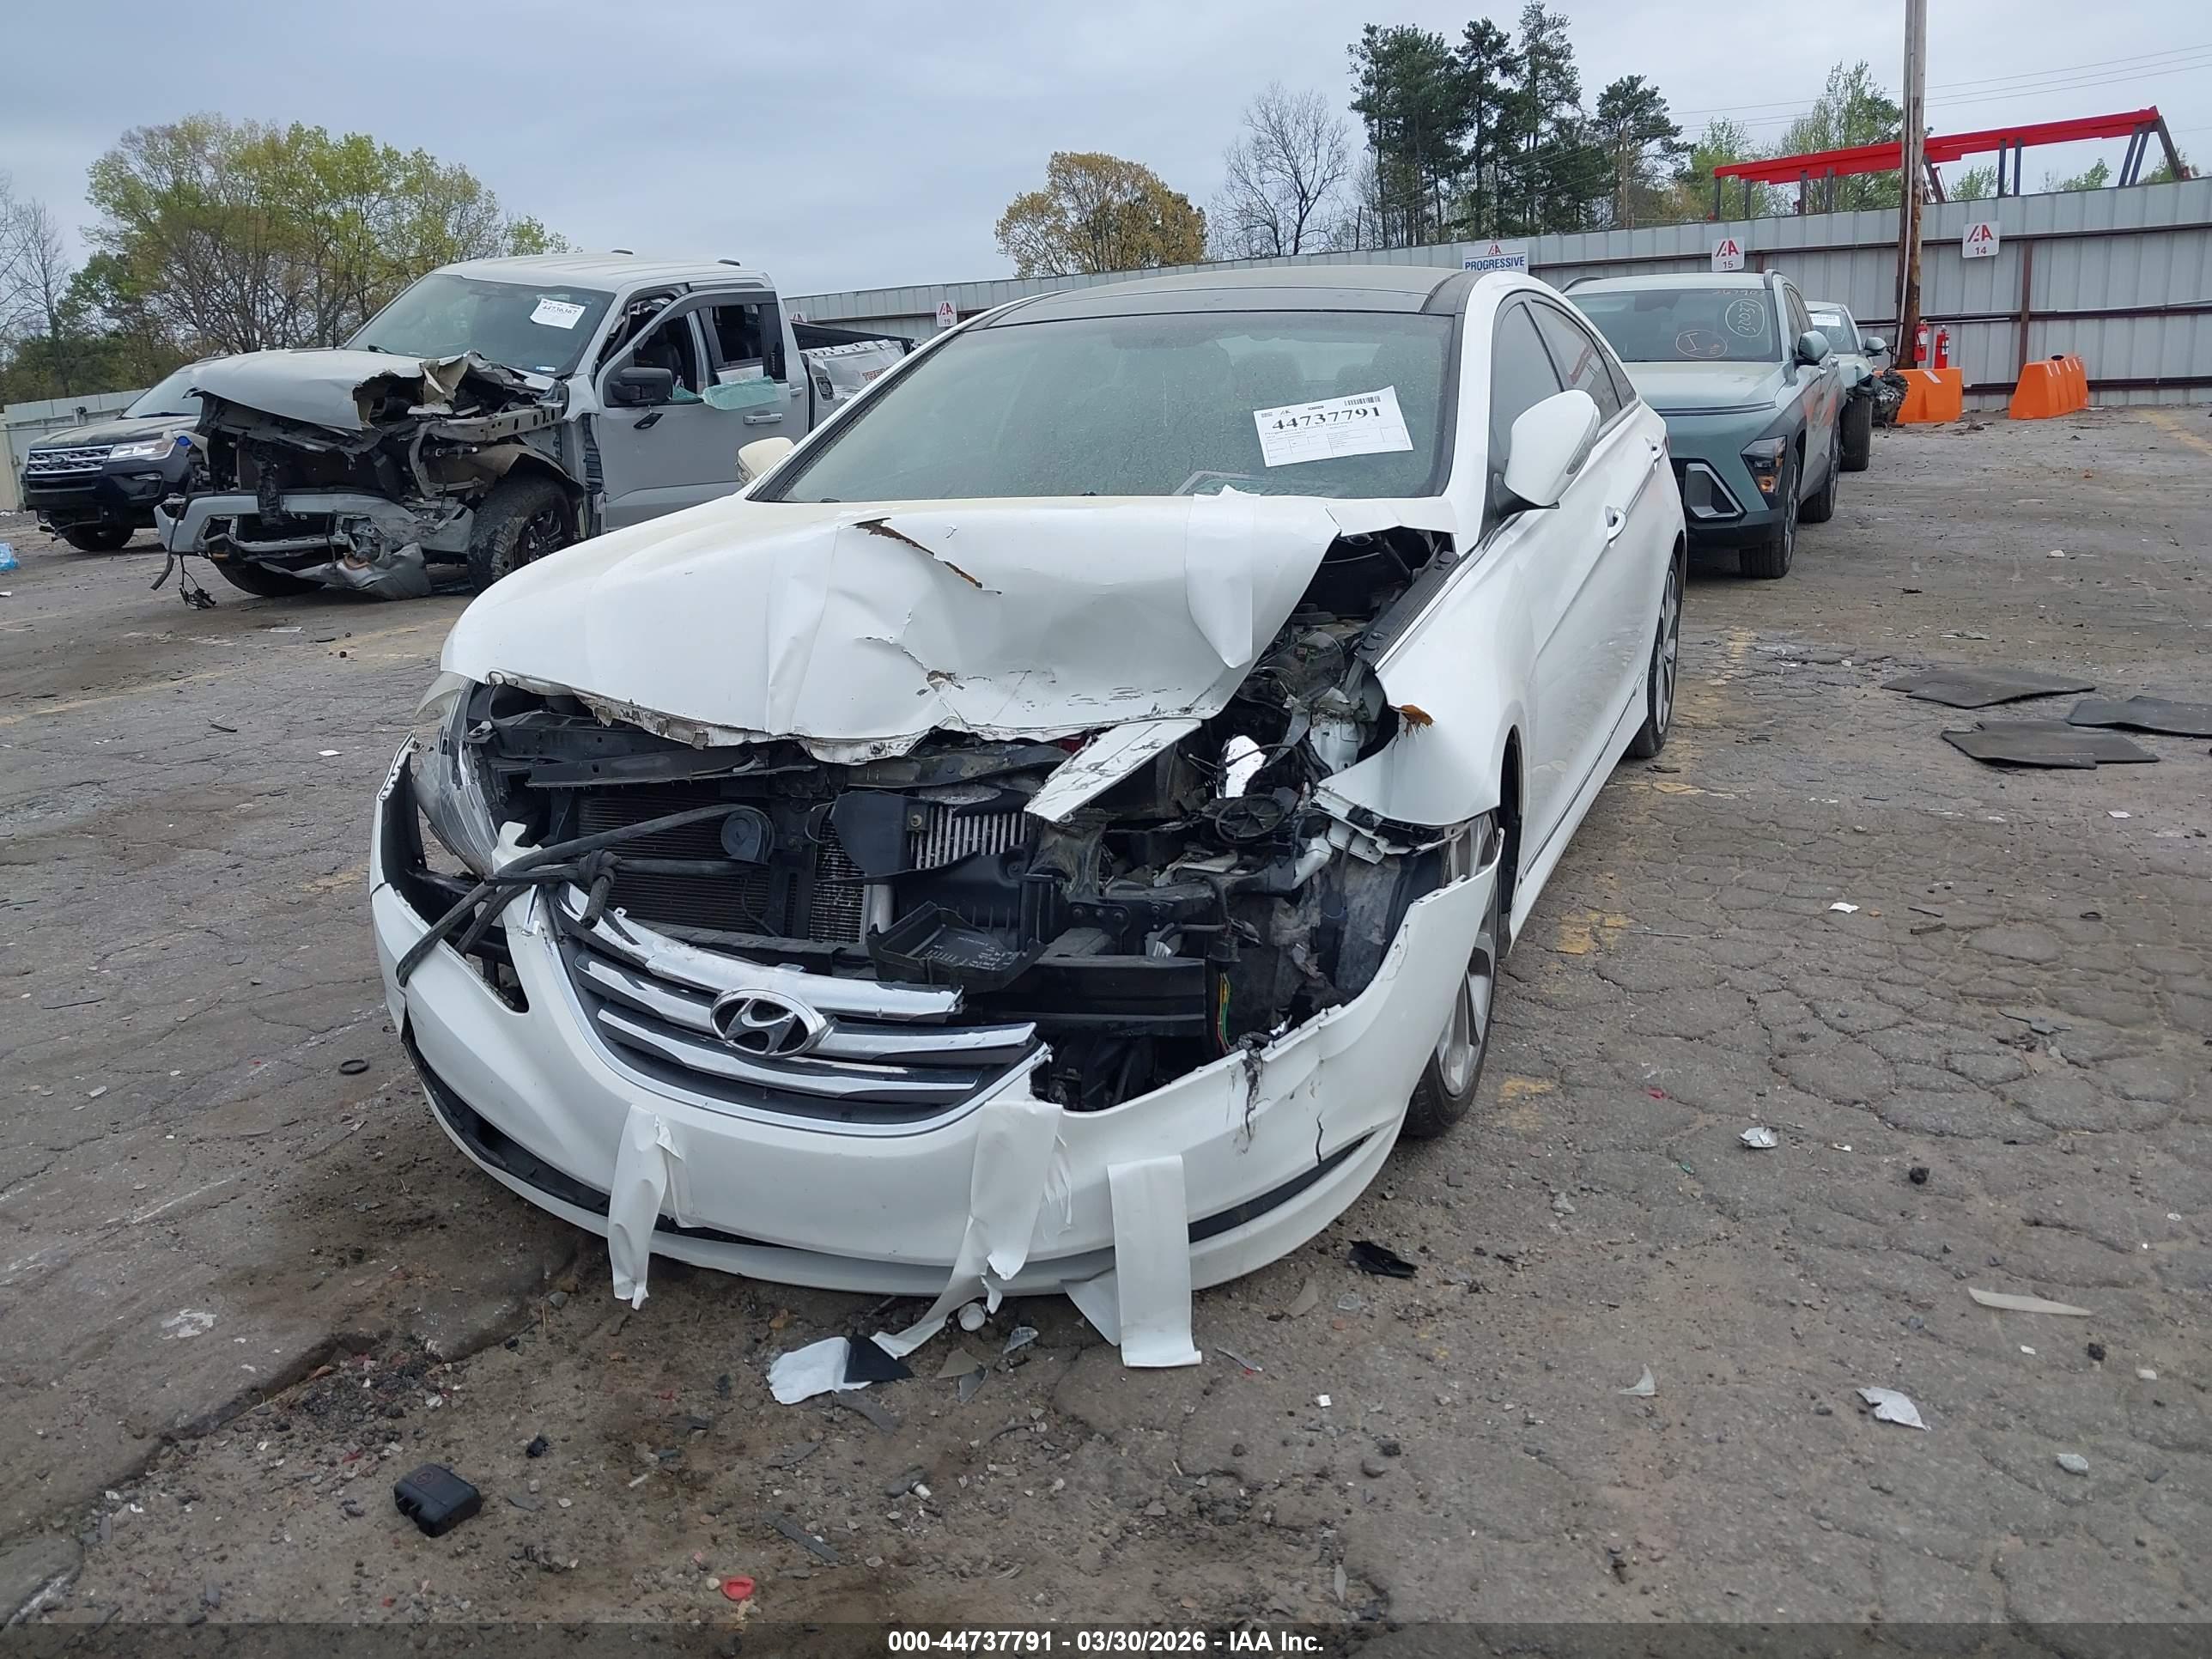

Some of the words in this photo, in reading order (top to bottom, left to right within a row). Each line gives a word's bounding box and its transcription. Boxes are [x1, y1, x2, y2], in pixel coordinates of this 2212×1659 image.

[1974, 246, 1987, 255] 14
[1465, 256, 1525, 271] PROGRESSIVE
[1723, 260, 1734, 269] 15
[1272, 406, 1380, 430] 44737791
